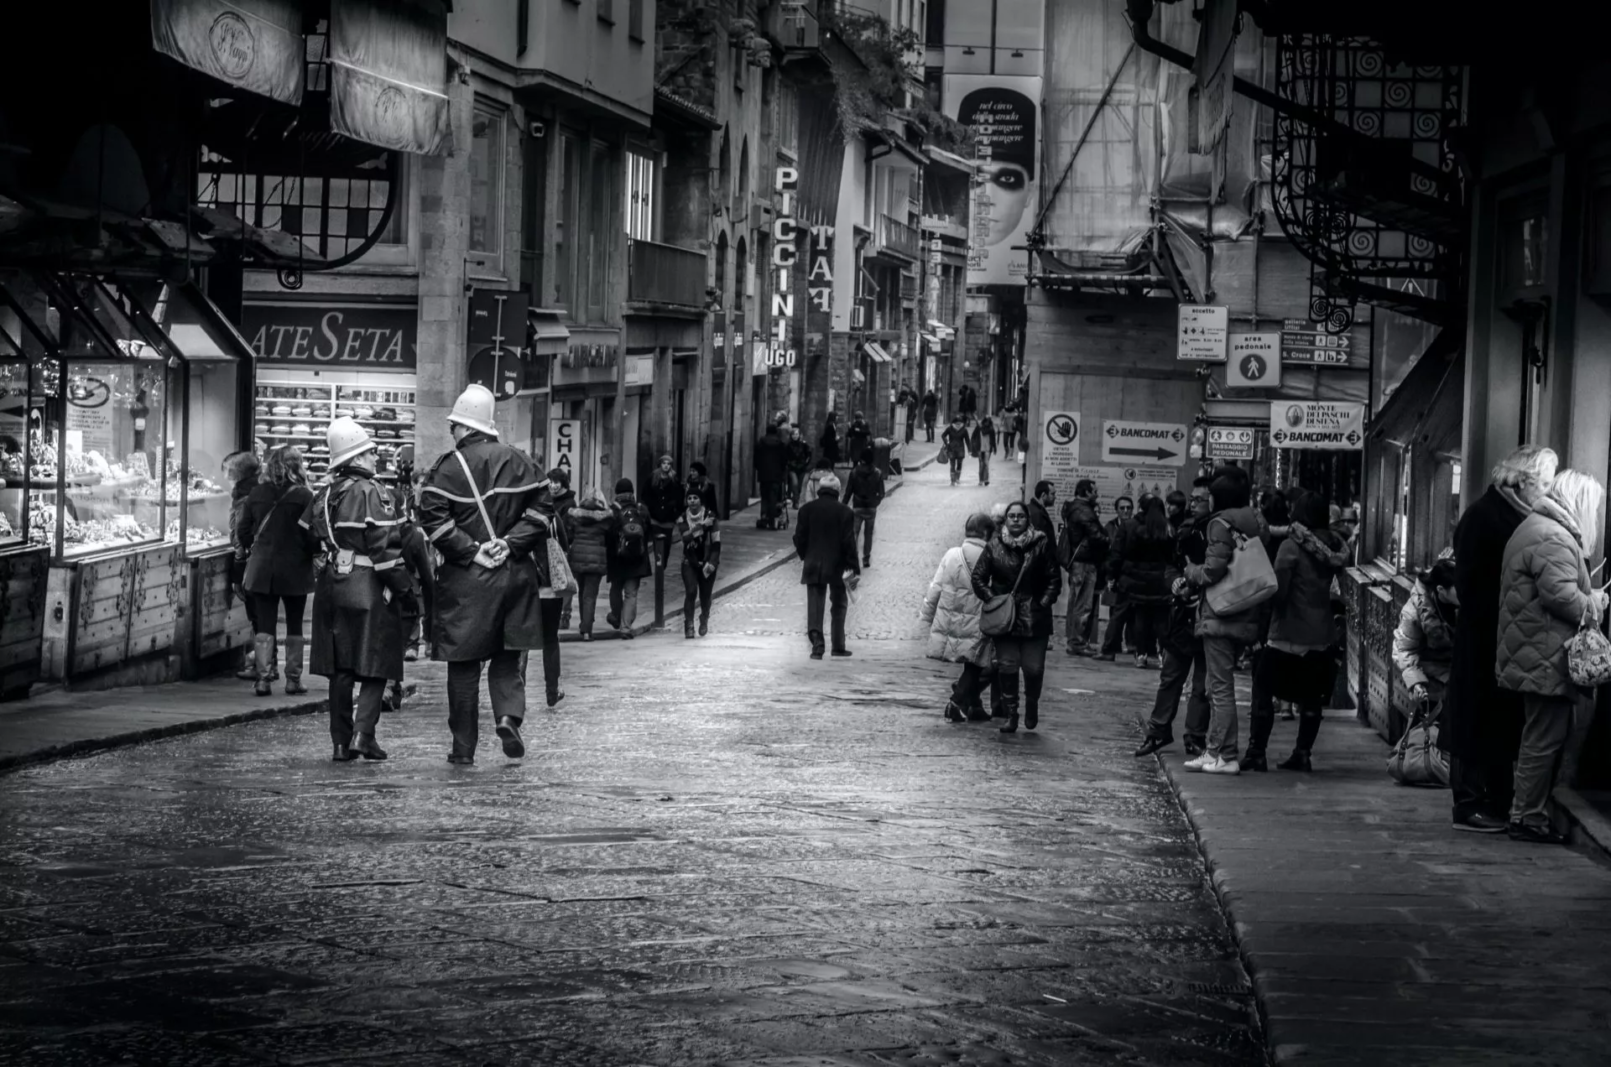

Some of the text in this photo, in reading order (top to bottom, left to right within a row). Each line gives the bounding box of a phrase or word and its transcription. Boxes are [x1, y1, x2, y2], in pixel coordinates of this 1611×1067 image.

[772, 166, 799, 342] PICCINI
[1234, 344, 1272, 352] pedonale
[765, 349, 796, 367] UGO
[1291, 351, 1311, 359] Croce
[1120, 428, 1171, 439] BANCOMAT
[1289, 432, 1345, 443] BANCOMAT
[557, 424, 571, 483] CHA
